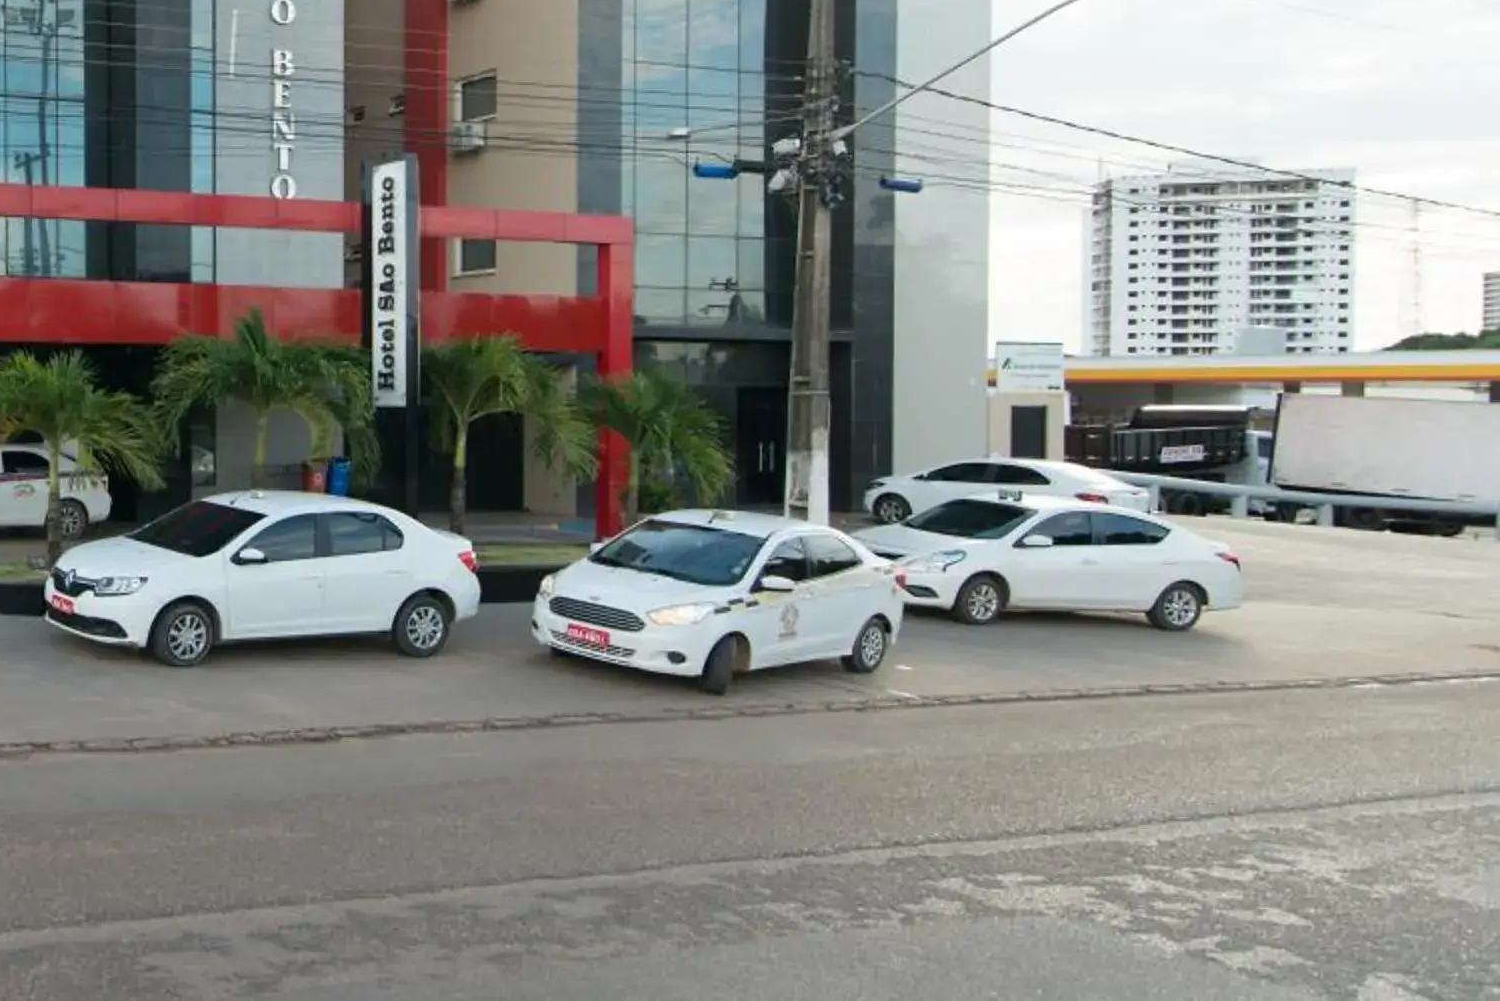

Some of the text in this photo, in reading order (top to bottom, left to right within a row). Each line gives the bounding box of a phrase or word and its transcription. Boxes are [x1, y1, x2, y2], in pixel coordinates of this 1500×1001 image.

[271, 47, 297, 200] BENTO
[377, 176, 395, 256] Bento
[377, 319, 395, 391] Hotel
